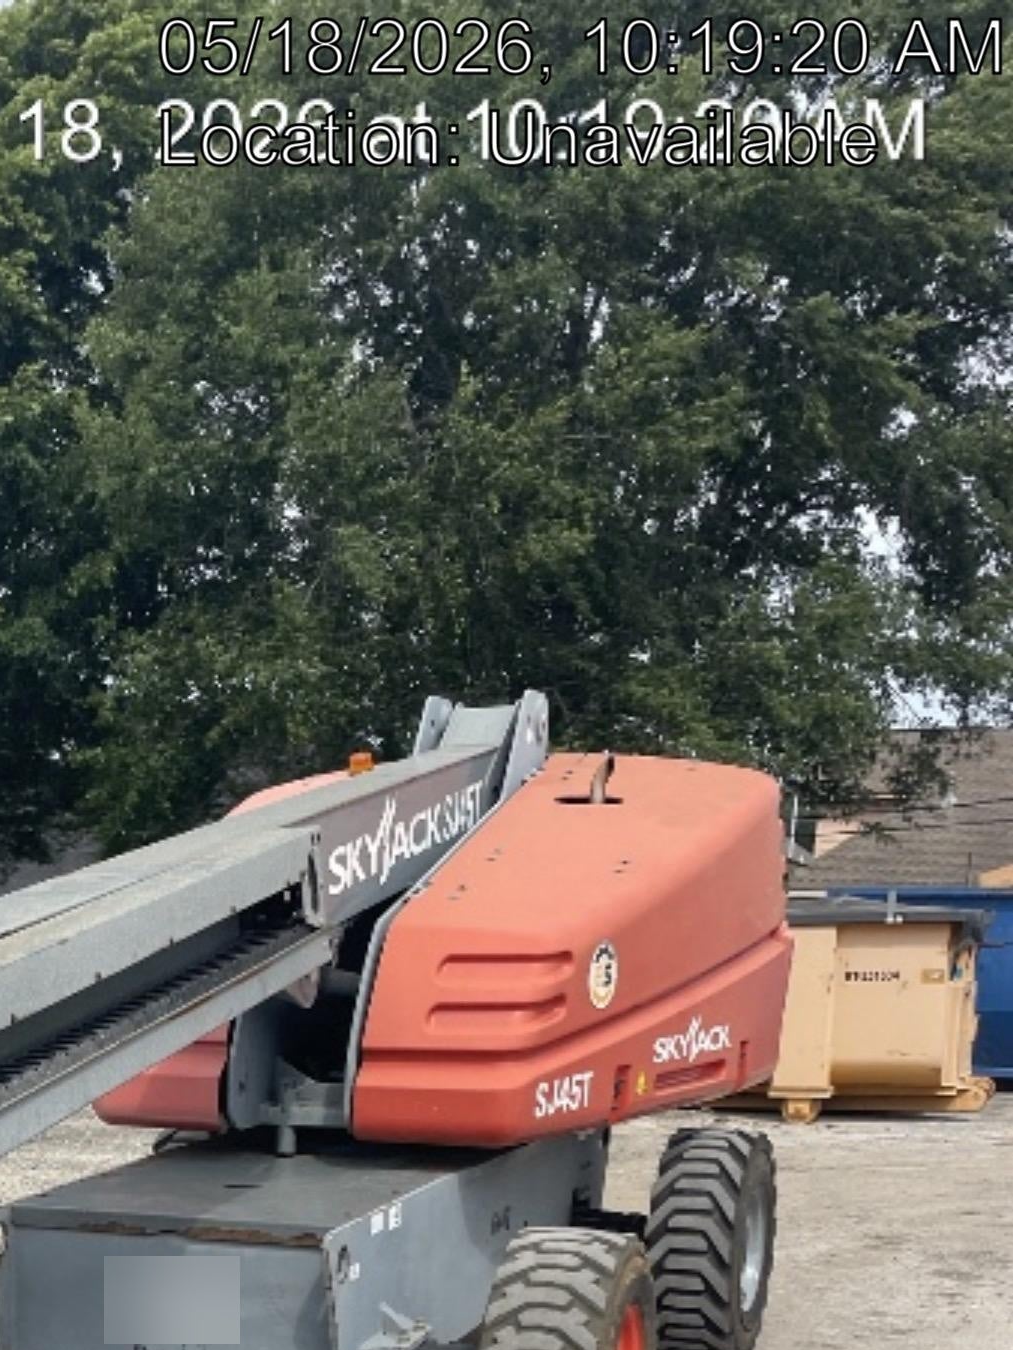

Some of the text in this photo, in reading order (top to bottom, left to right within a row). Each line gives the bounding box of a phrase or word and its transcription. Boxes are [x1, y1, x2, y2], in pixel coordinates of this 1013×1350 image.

[328, 779, 483, 895] SKYJACK SJ45T
[653, 1016, 732, 1062] SKYJACK
[535, 1071, 594, 1119] SJ45T
